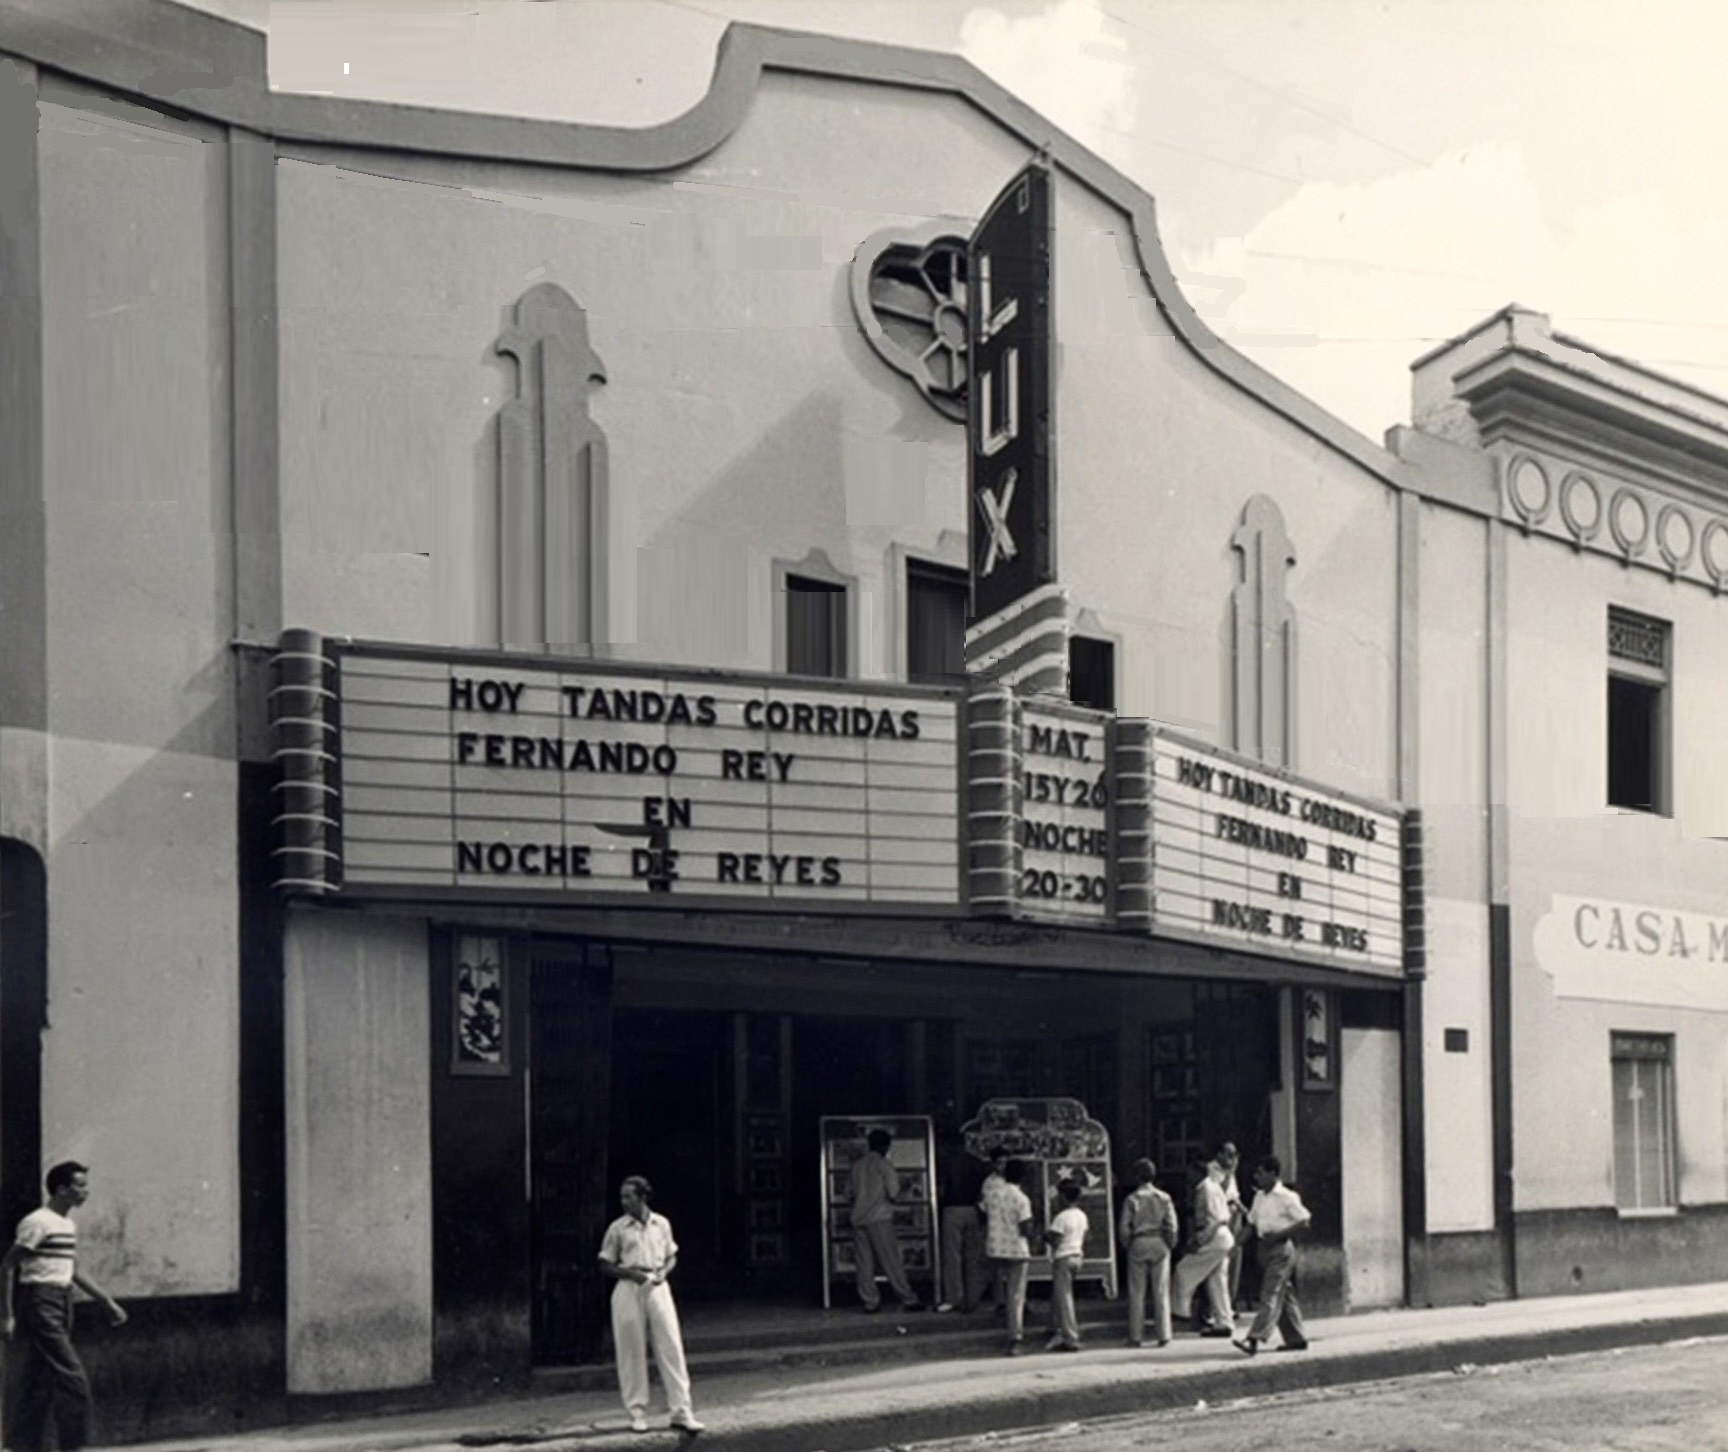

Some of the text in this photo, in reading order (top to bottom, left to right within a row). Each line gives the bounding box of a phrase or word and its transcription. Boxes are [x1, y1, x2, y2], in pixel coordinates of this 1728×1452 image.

[980, 254, 1018, 577] LUX
[449, 677, 921, 740] HOY TANDAS CORRIDAS
[458, 733, 795, 784] FERNANDO REY
[1030, 724, 1091, 763] MAT.
[644, 796, 691, 828] EN
[1178, 757, 1377, 842] HOY TANDAS CORRIDAS
[457, 841, 842, 886] NOCHE DE REYES
[1024, 820, 1107, 858] NOCHE
[1216, 813, 1358, 874] FERNANDO REY
[1023, 868, 1107, 902] 20-30
[1277, 871, 1302, 899] EN
[1212, 898, 1368, 951] NOCHE DE REYES
[1575, 903, 1690, 958] CASA
